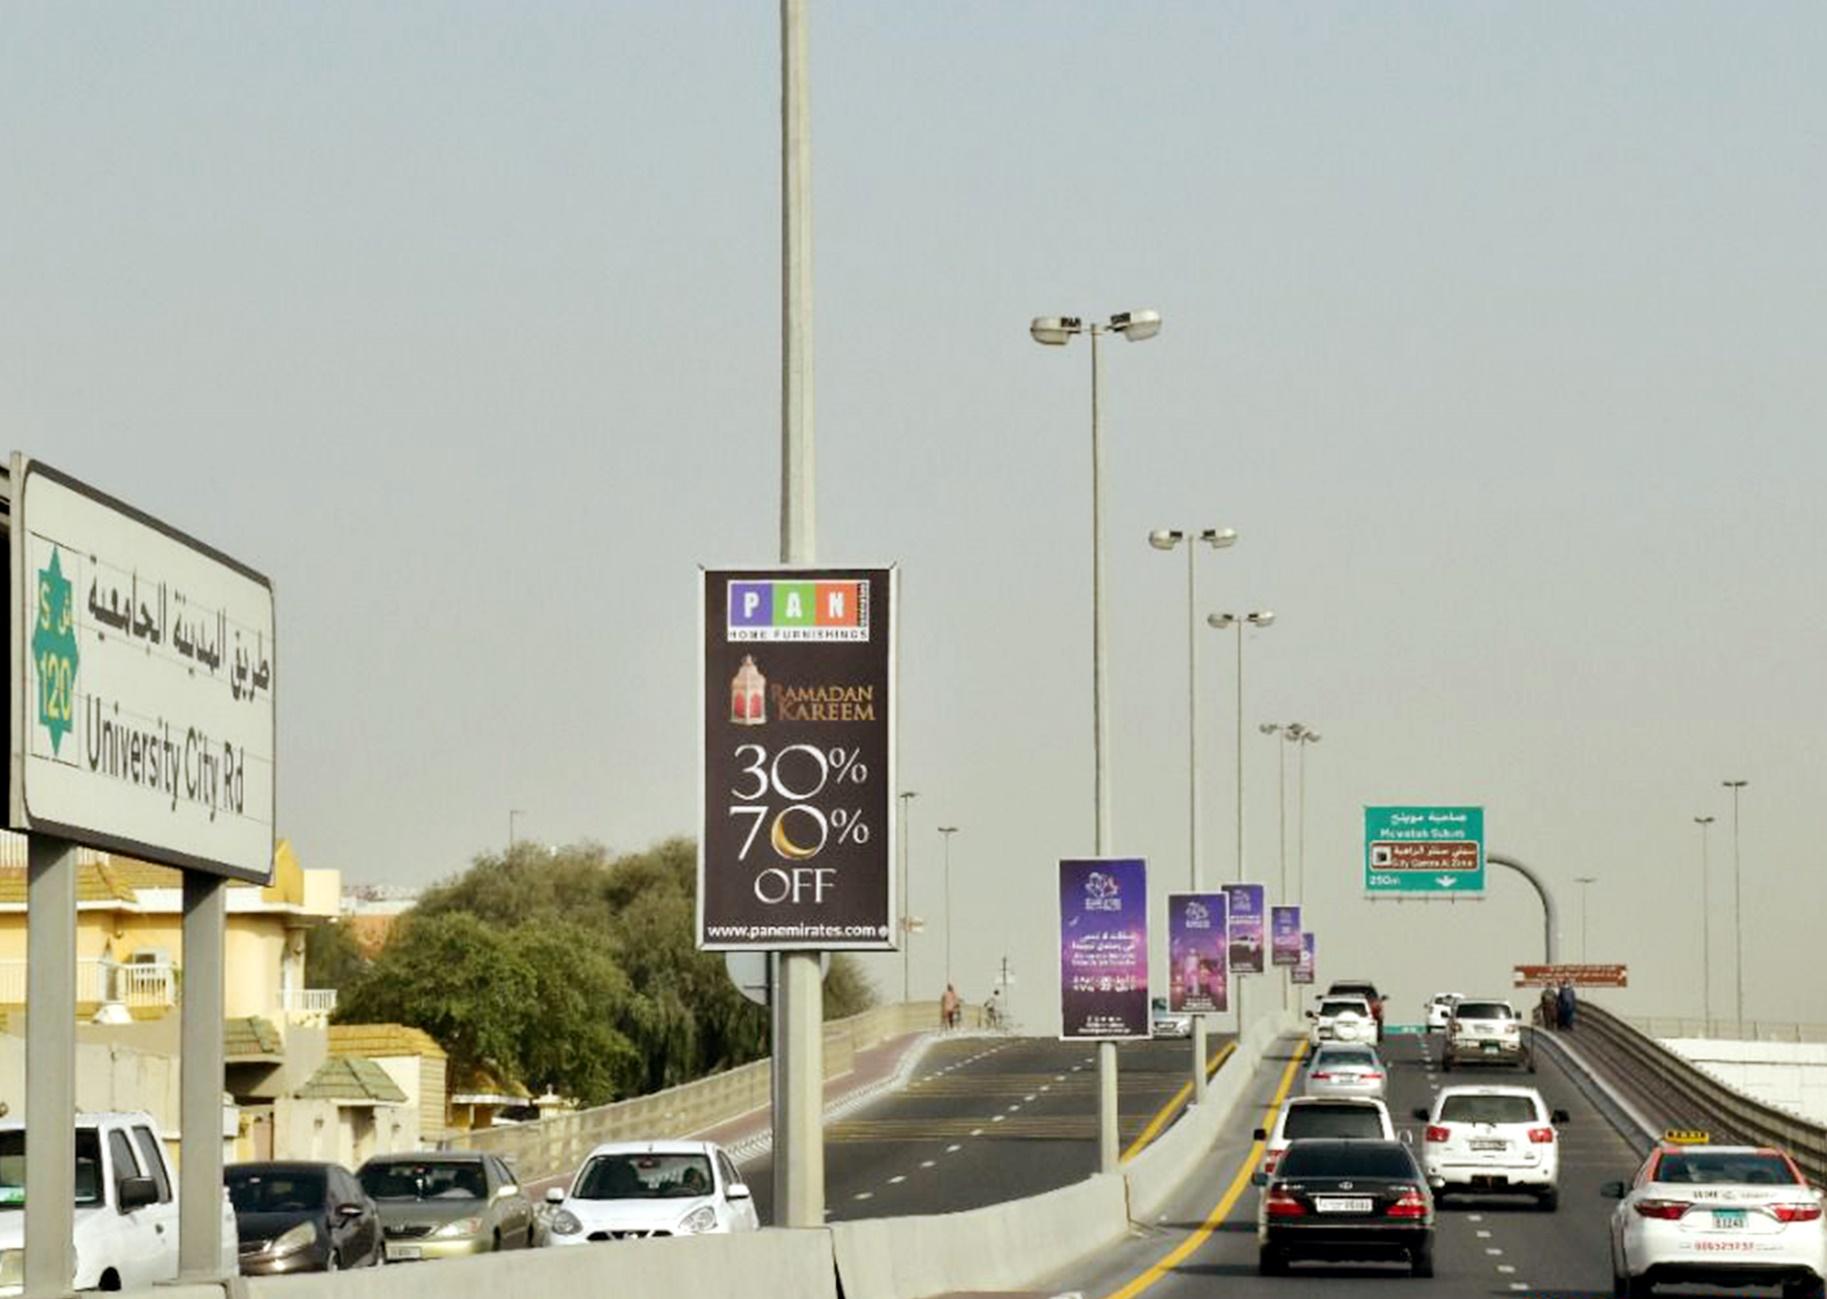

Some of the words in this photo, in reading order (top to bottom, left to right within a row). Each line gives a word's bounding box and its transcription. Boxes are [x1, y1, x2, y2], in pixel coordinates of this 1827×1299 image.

[41, 580, 50, 631] S
[88, 554, 168, 657] الجامعية
[743, 591, 845, 618] PAN
[173, 589, 226, 677] المدينة
[728, 629, 768, 640] HOME
[774, 629, 867, 640] FURNISHINGS
[40, 652, 73, 721] 120
[230, 629, 270, 703] طريق
[769, 683, 874, 702] RAMADAN
[778, 701, 877, 721] KAREEM
[87, 693, 180, 812] University
[184, 726, 219, 822] City
[224, 740, 245, 814] Rd
[731, 743, 868, 800] 30%
[729, 804, 870, 861] 70%
[754, 867, 837, 904] OFF
[707, 922, 876, 940] www.panemirates.com
